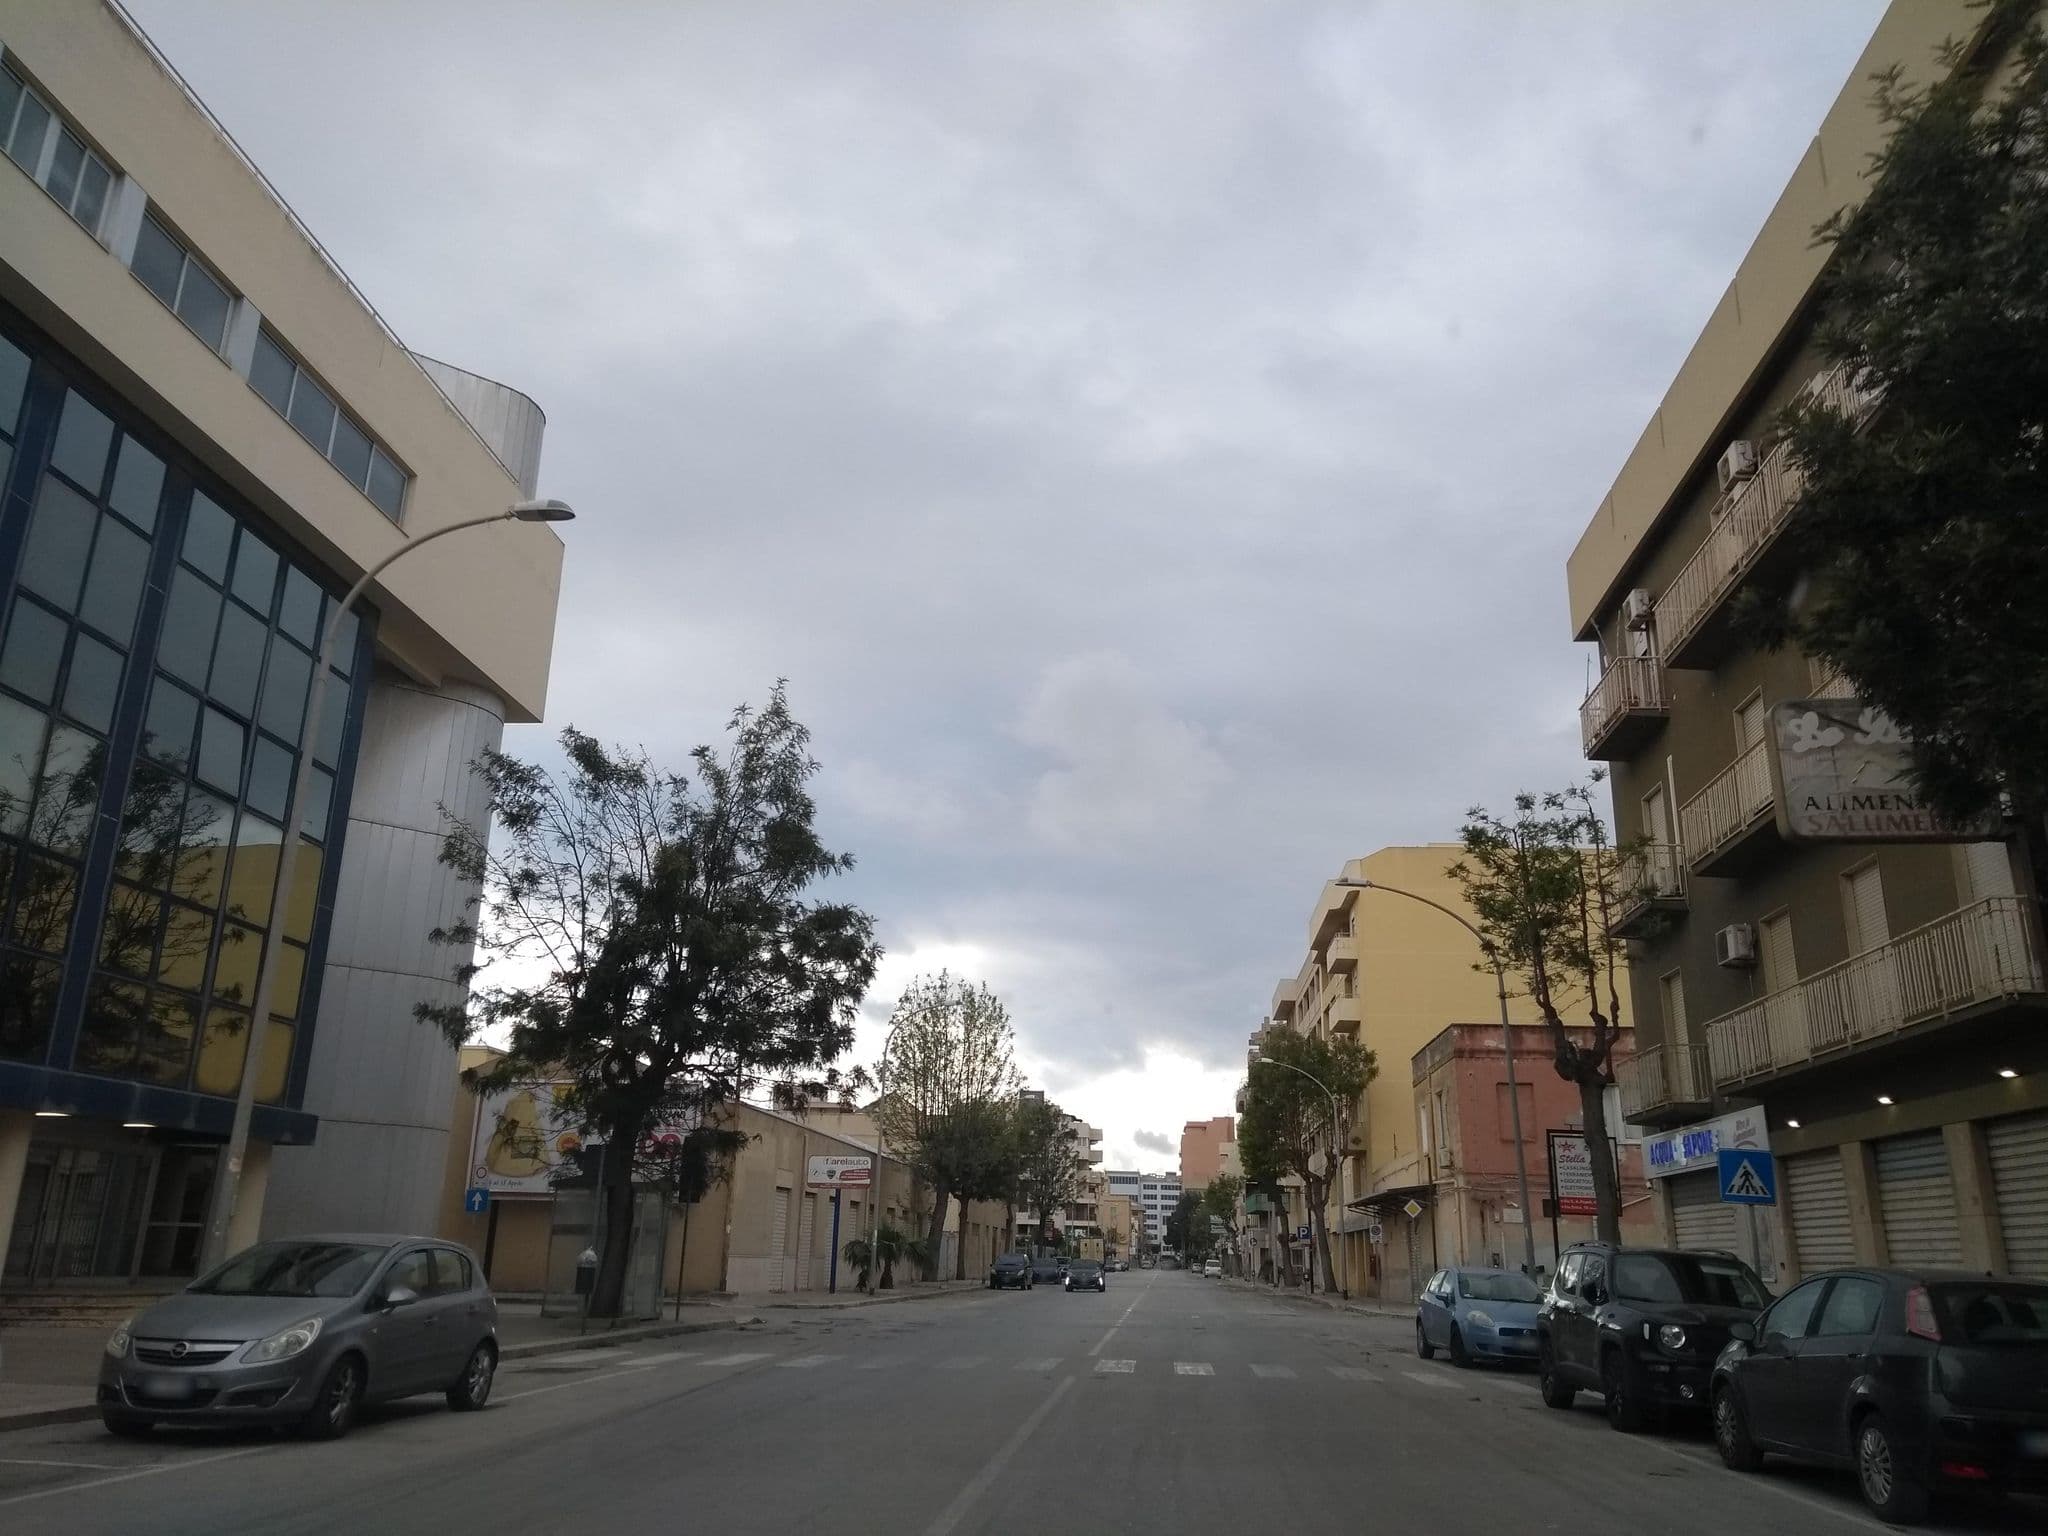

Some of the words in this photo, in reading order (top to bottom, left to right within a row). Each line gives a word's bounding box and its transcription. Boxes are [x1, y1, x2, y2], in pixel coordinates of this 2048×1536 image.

[1650, 1140, 1675, 1165] ACQUA
[1558, 1154, 1586, 1164] Stella
[1300, 1228, 1308, 1238] P
